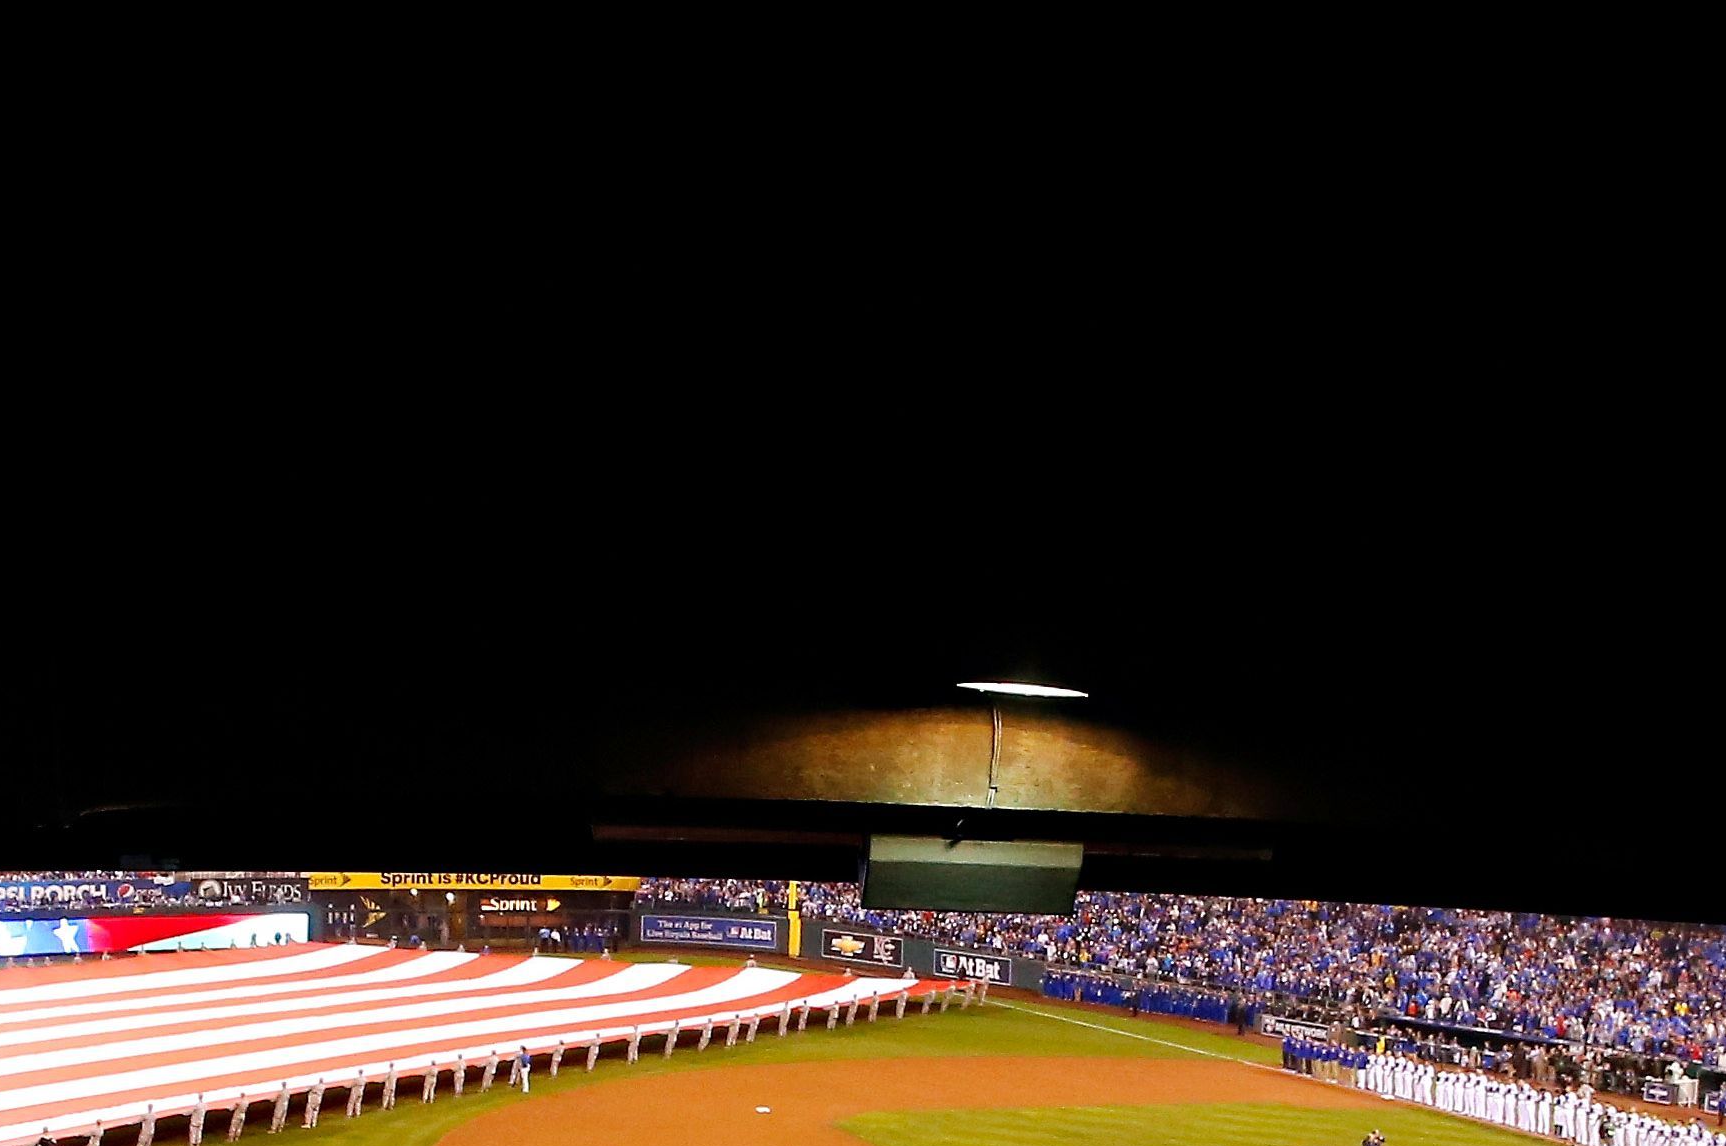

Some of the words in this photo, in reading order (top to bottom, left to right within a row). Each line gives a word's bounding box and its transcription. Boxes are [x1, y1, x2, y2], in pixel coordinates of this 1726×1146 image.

[380, 872, 433, 887] Sprint
[438, 873, 451, 885] is
[570, 876, 599, 888] Sprint
[490, 897, 538, 911] Sprint
[753, 927, 772, 941] Bat
[975, 958, 1001, 980] Bat
